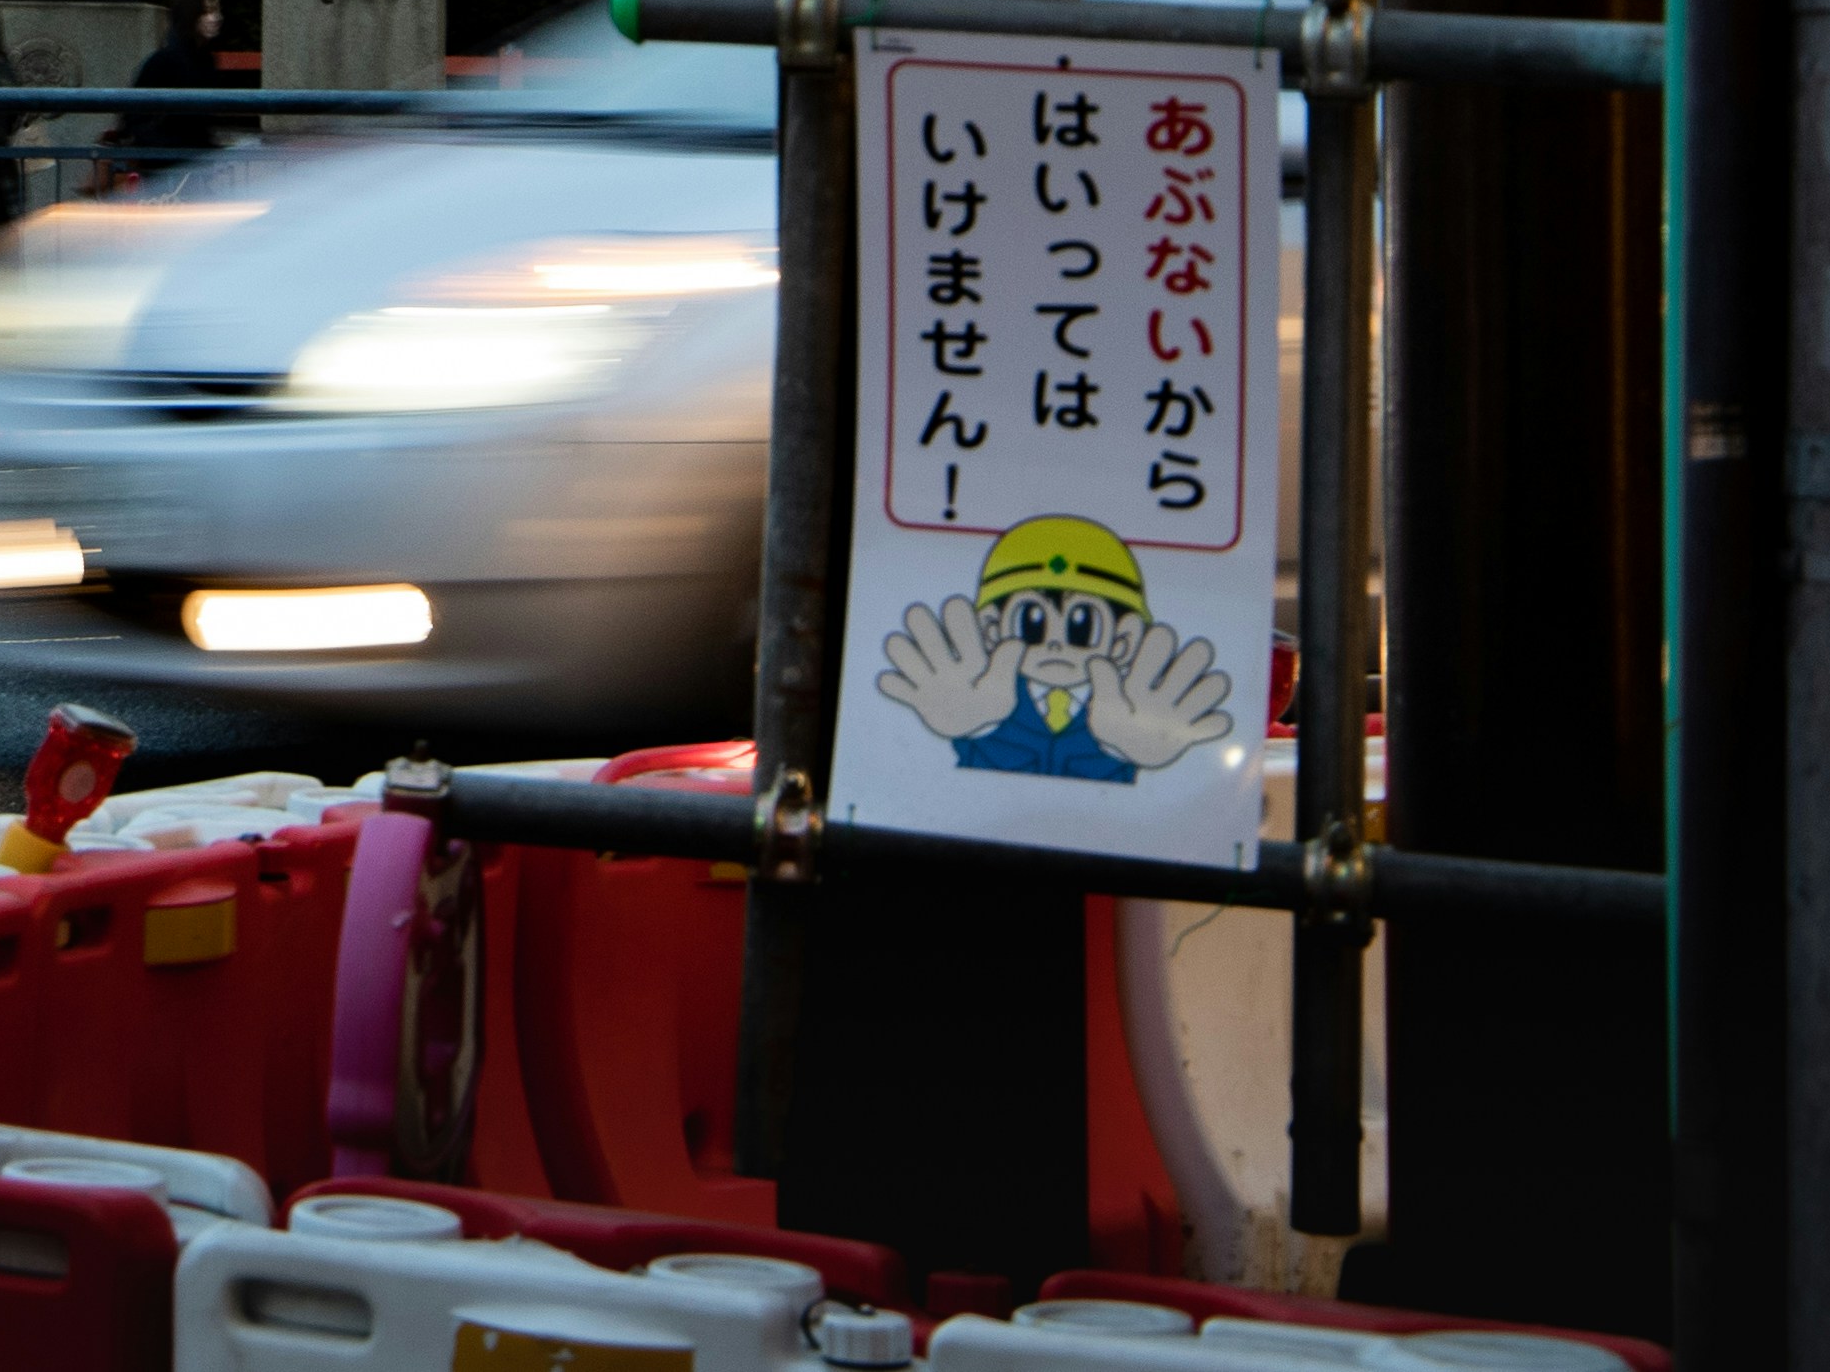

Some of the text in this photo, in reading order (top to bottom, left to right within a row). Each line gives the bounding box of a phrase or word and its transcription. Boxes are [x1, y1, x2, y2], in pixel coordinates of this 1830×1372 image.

[1032, 91, 1101, 430] はいっては
[1144, 95, 1215, 510] あぶないから
